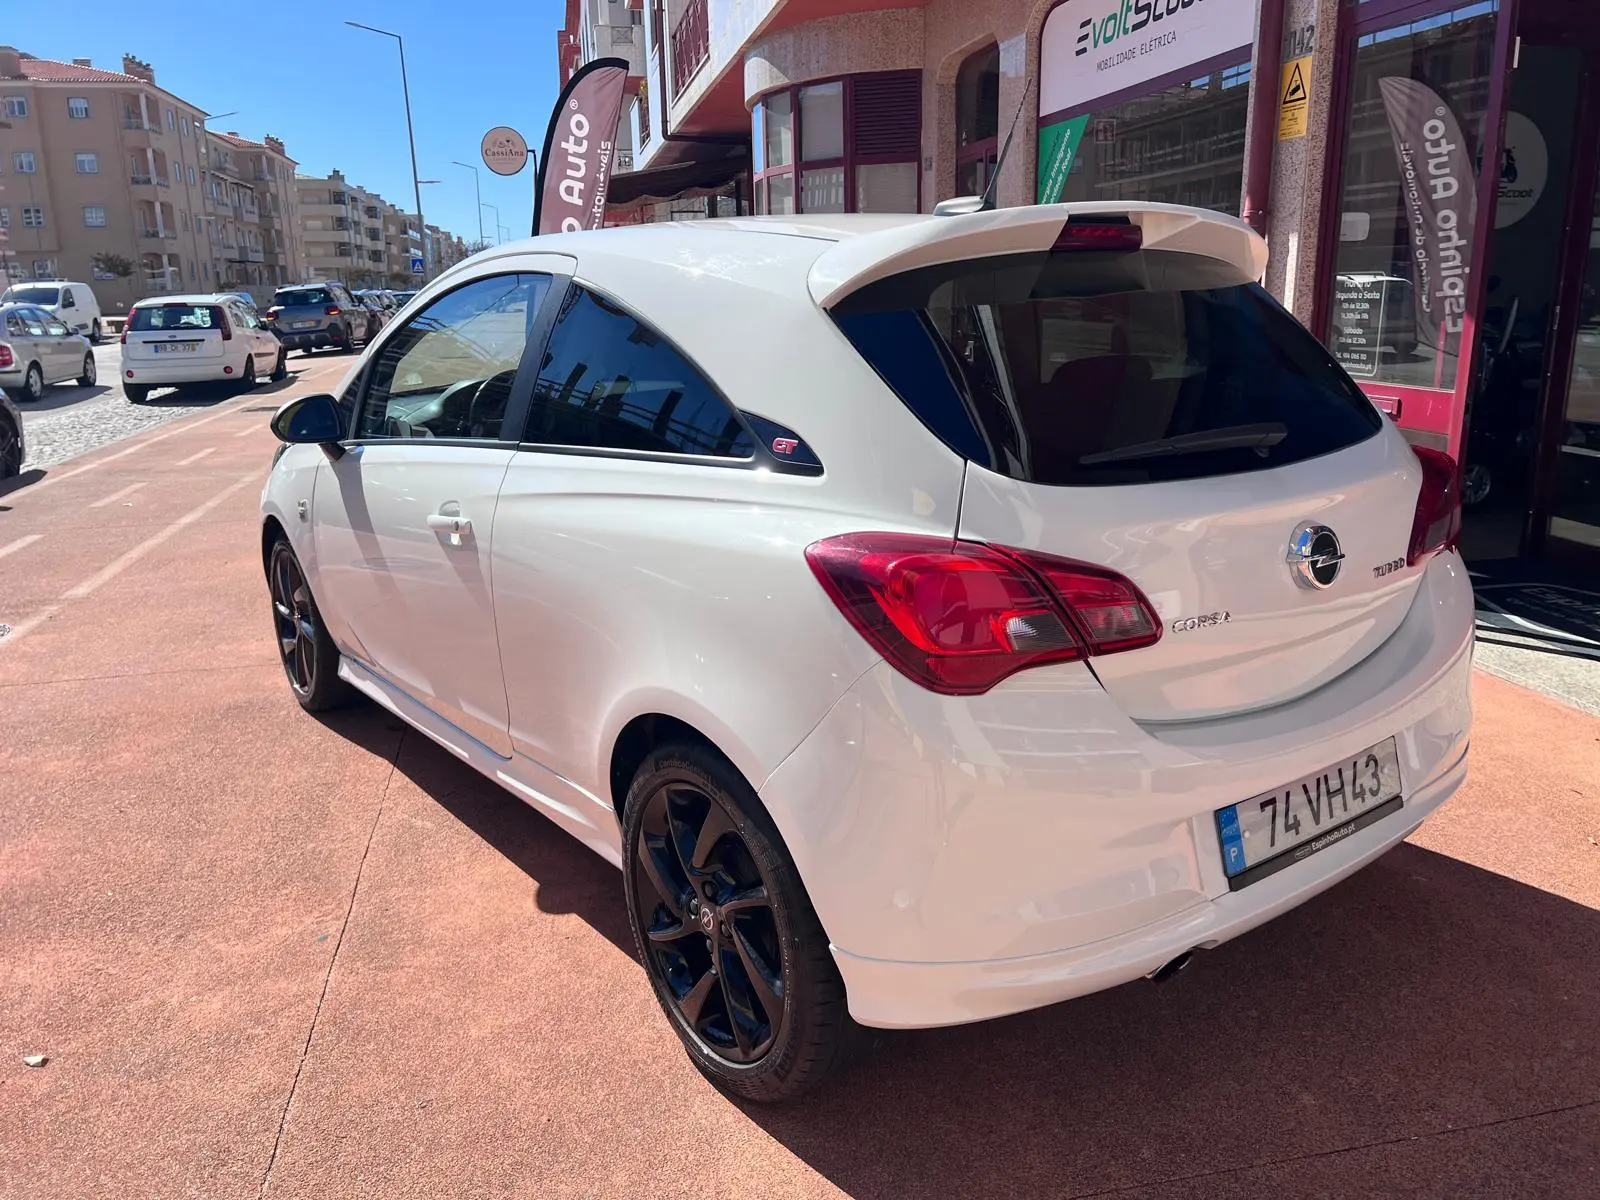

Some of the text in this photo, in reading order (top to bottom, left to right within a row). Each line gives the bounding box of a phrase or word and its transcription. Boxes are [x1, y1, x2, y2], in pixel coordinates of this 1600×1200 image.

[1096, 30, 1177, 72] MOBILIDADE ELÉTRICA
[1336, 291, 1357, 301] Segunda
[1363, 291, 1380, 299] Sexta
[772, 437, 799, 455] GT
[1373, 558, 1405, 579] TURBO
[1171, 610, 1232, 634] CORSA
[1311, 823, 1356, 851] EspinhoAuto.pt
[1229, 847, 1238, 863] P
